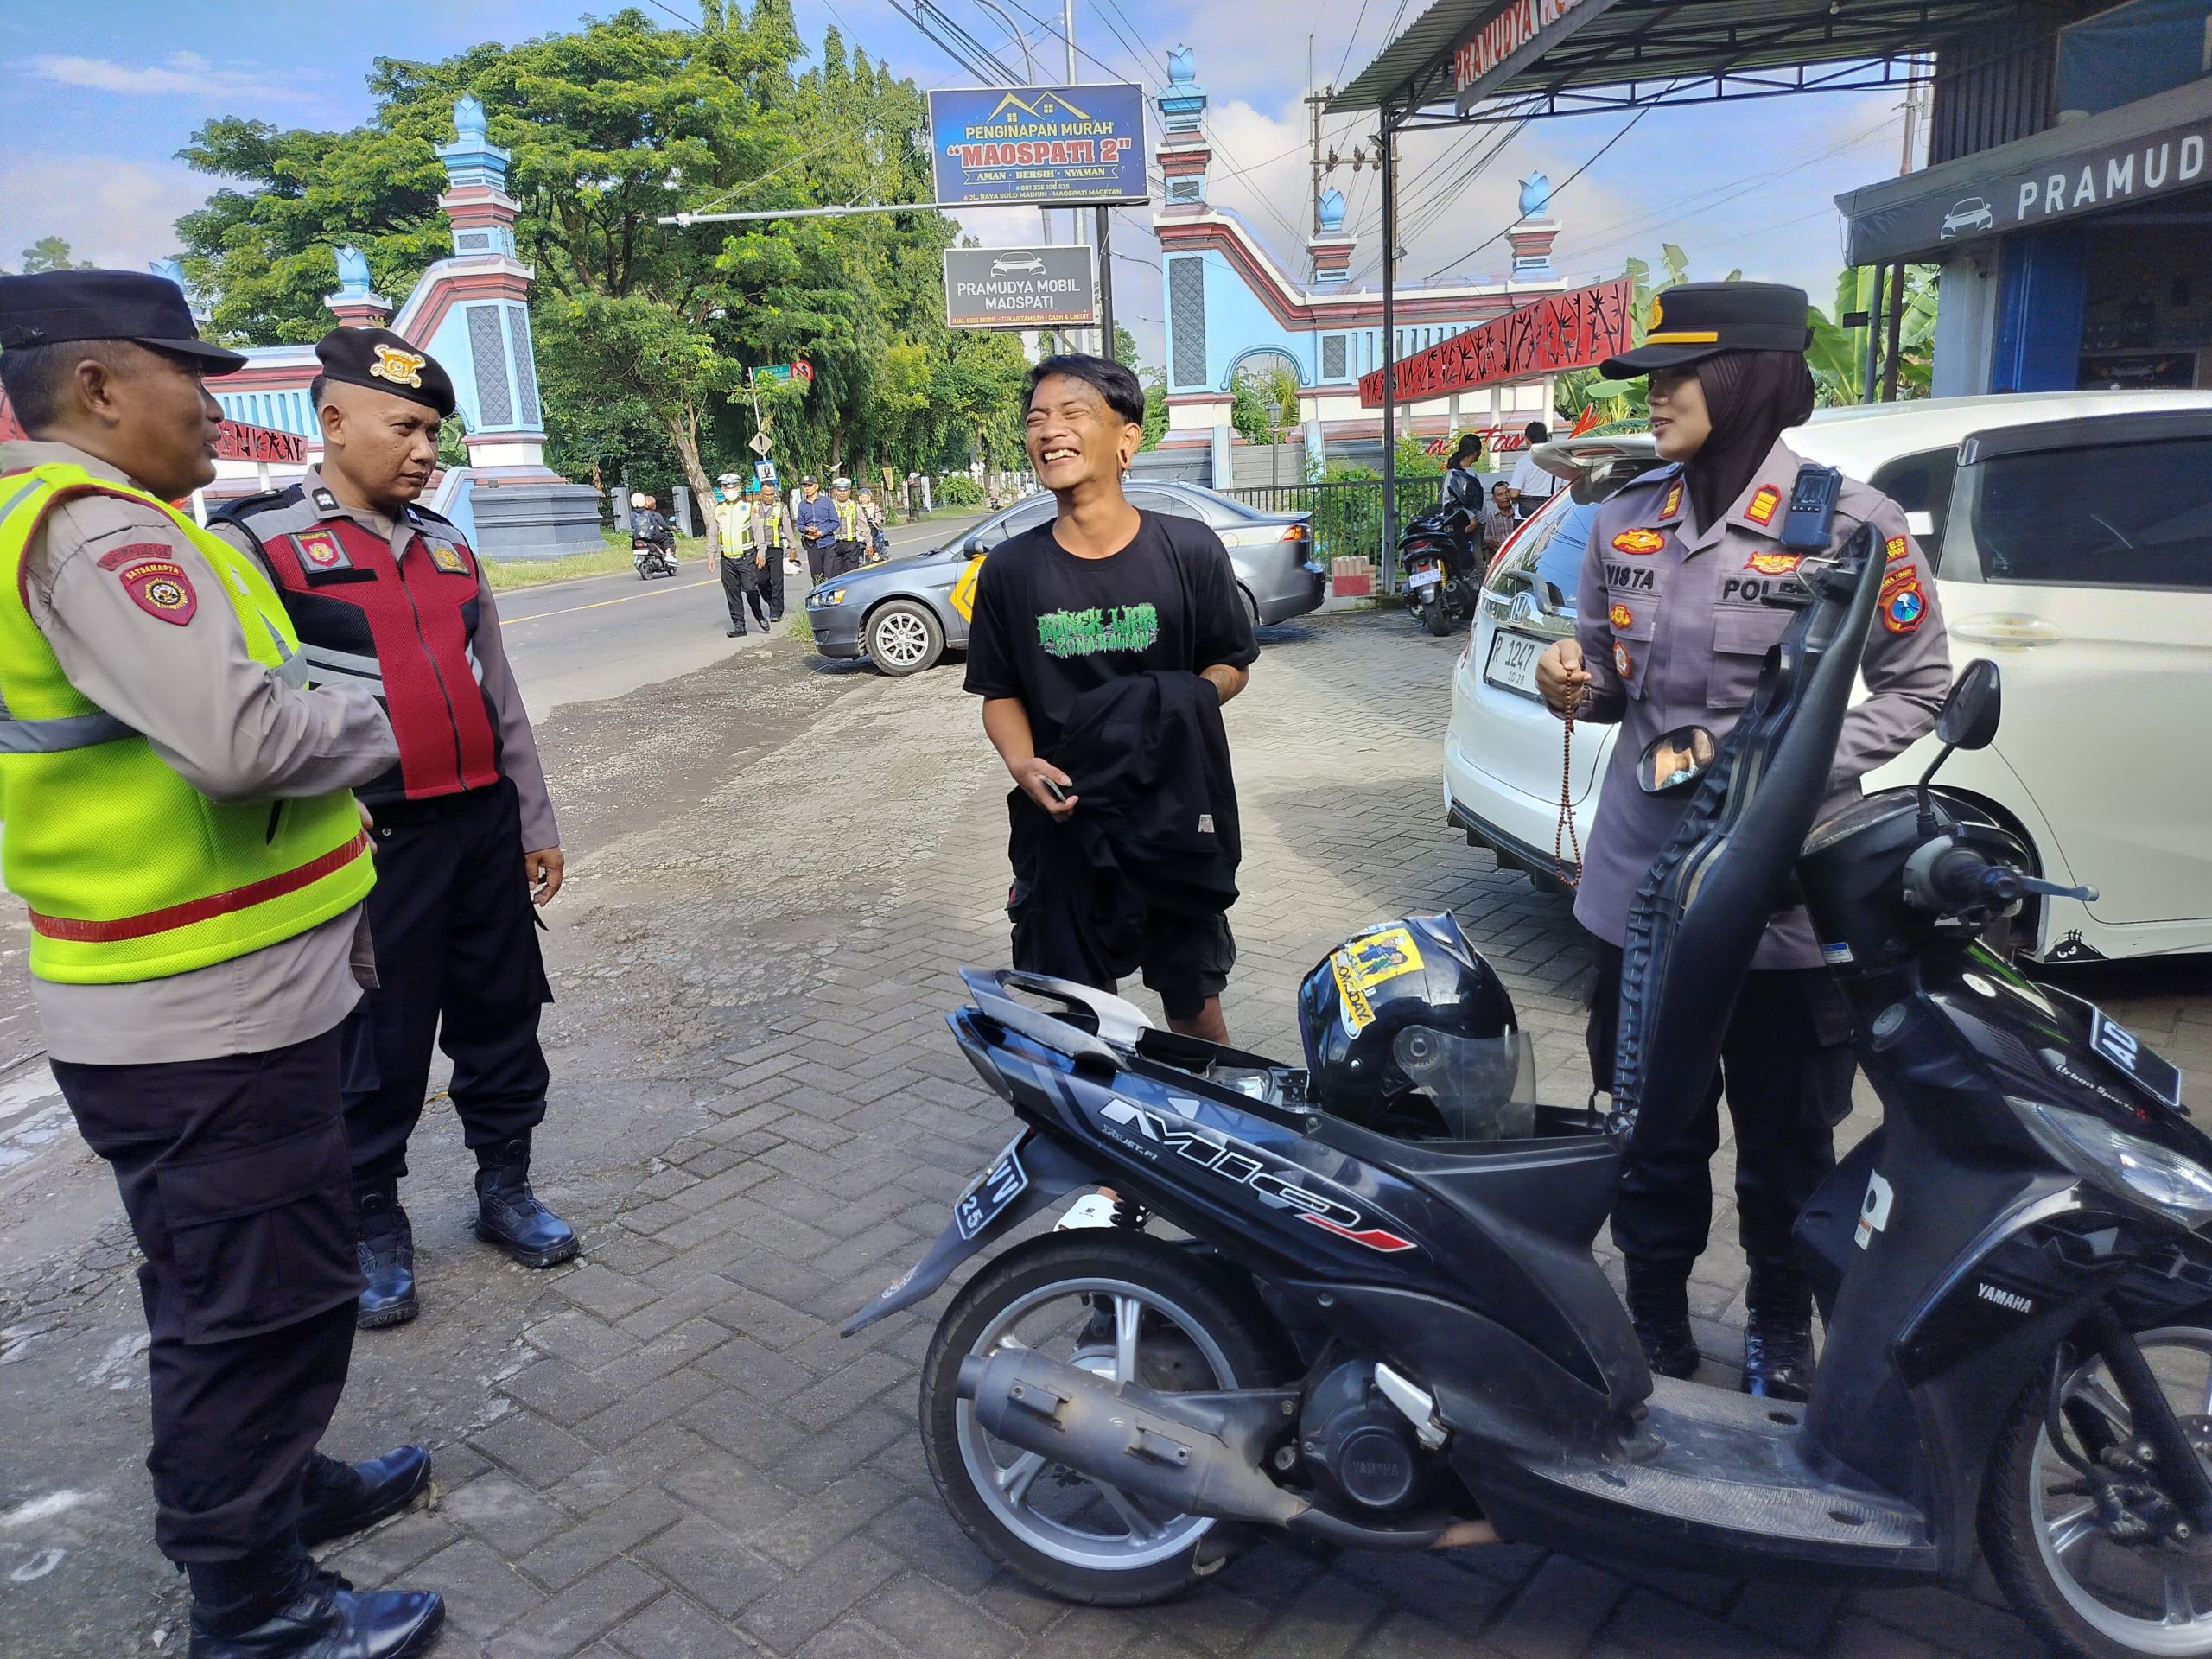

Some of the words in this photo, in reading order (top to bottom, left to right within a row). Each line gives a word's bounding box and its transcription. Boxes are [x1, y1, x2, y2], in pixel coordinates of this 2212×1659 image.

[1454, 0, 1537, 91] PRAMUDYA
[965, 124, 1058, 140] PENGINAPAN
[1061, 121, 1115, 137] MURAH
[977, 172, 1007, 181] AMAN
[1015, 169, 1055, 179] BERSIH
[1064, 168, 1105, 177] NYAMAN
[2018, 135, 2204, 221] PRAMUD
[957, 280, 1034, 296] PRAMUDYA
[1037, 278, 1081, 293] MOBIL
[985, 295, 1054, 311] MAOSPATI
[1606, 564, 1655, 589] VISTA
[1056, 635, 1095, 657] ZONA
[1096, 632, 1149, 652] RAWAN
[1504, 639, 1535, 671] 1247
[2102, 1021, 2138, 1071] AD
[2056, 1064, 2094, 1090] Urban
[2094, 1085, 2135, 1112] Sports
[1978, 1282, 2032, 1313] YAMAHA
[1353, 1460, 1399, 1476] YAMAHA
